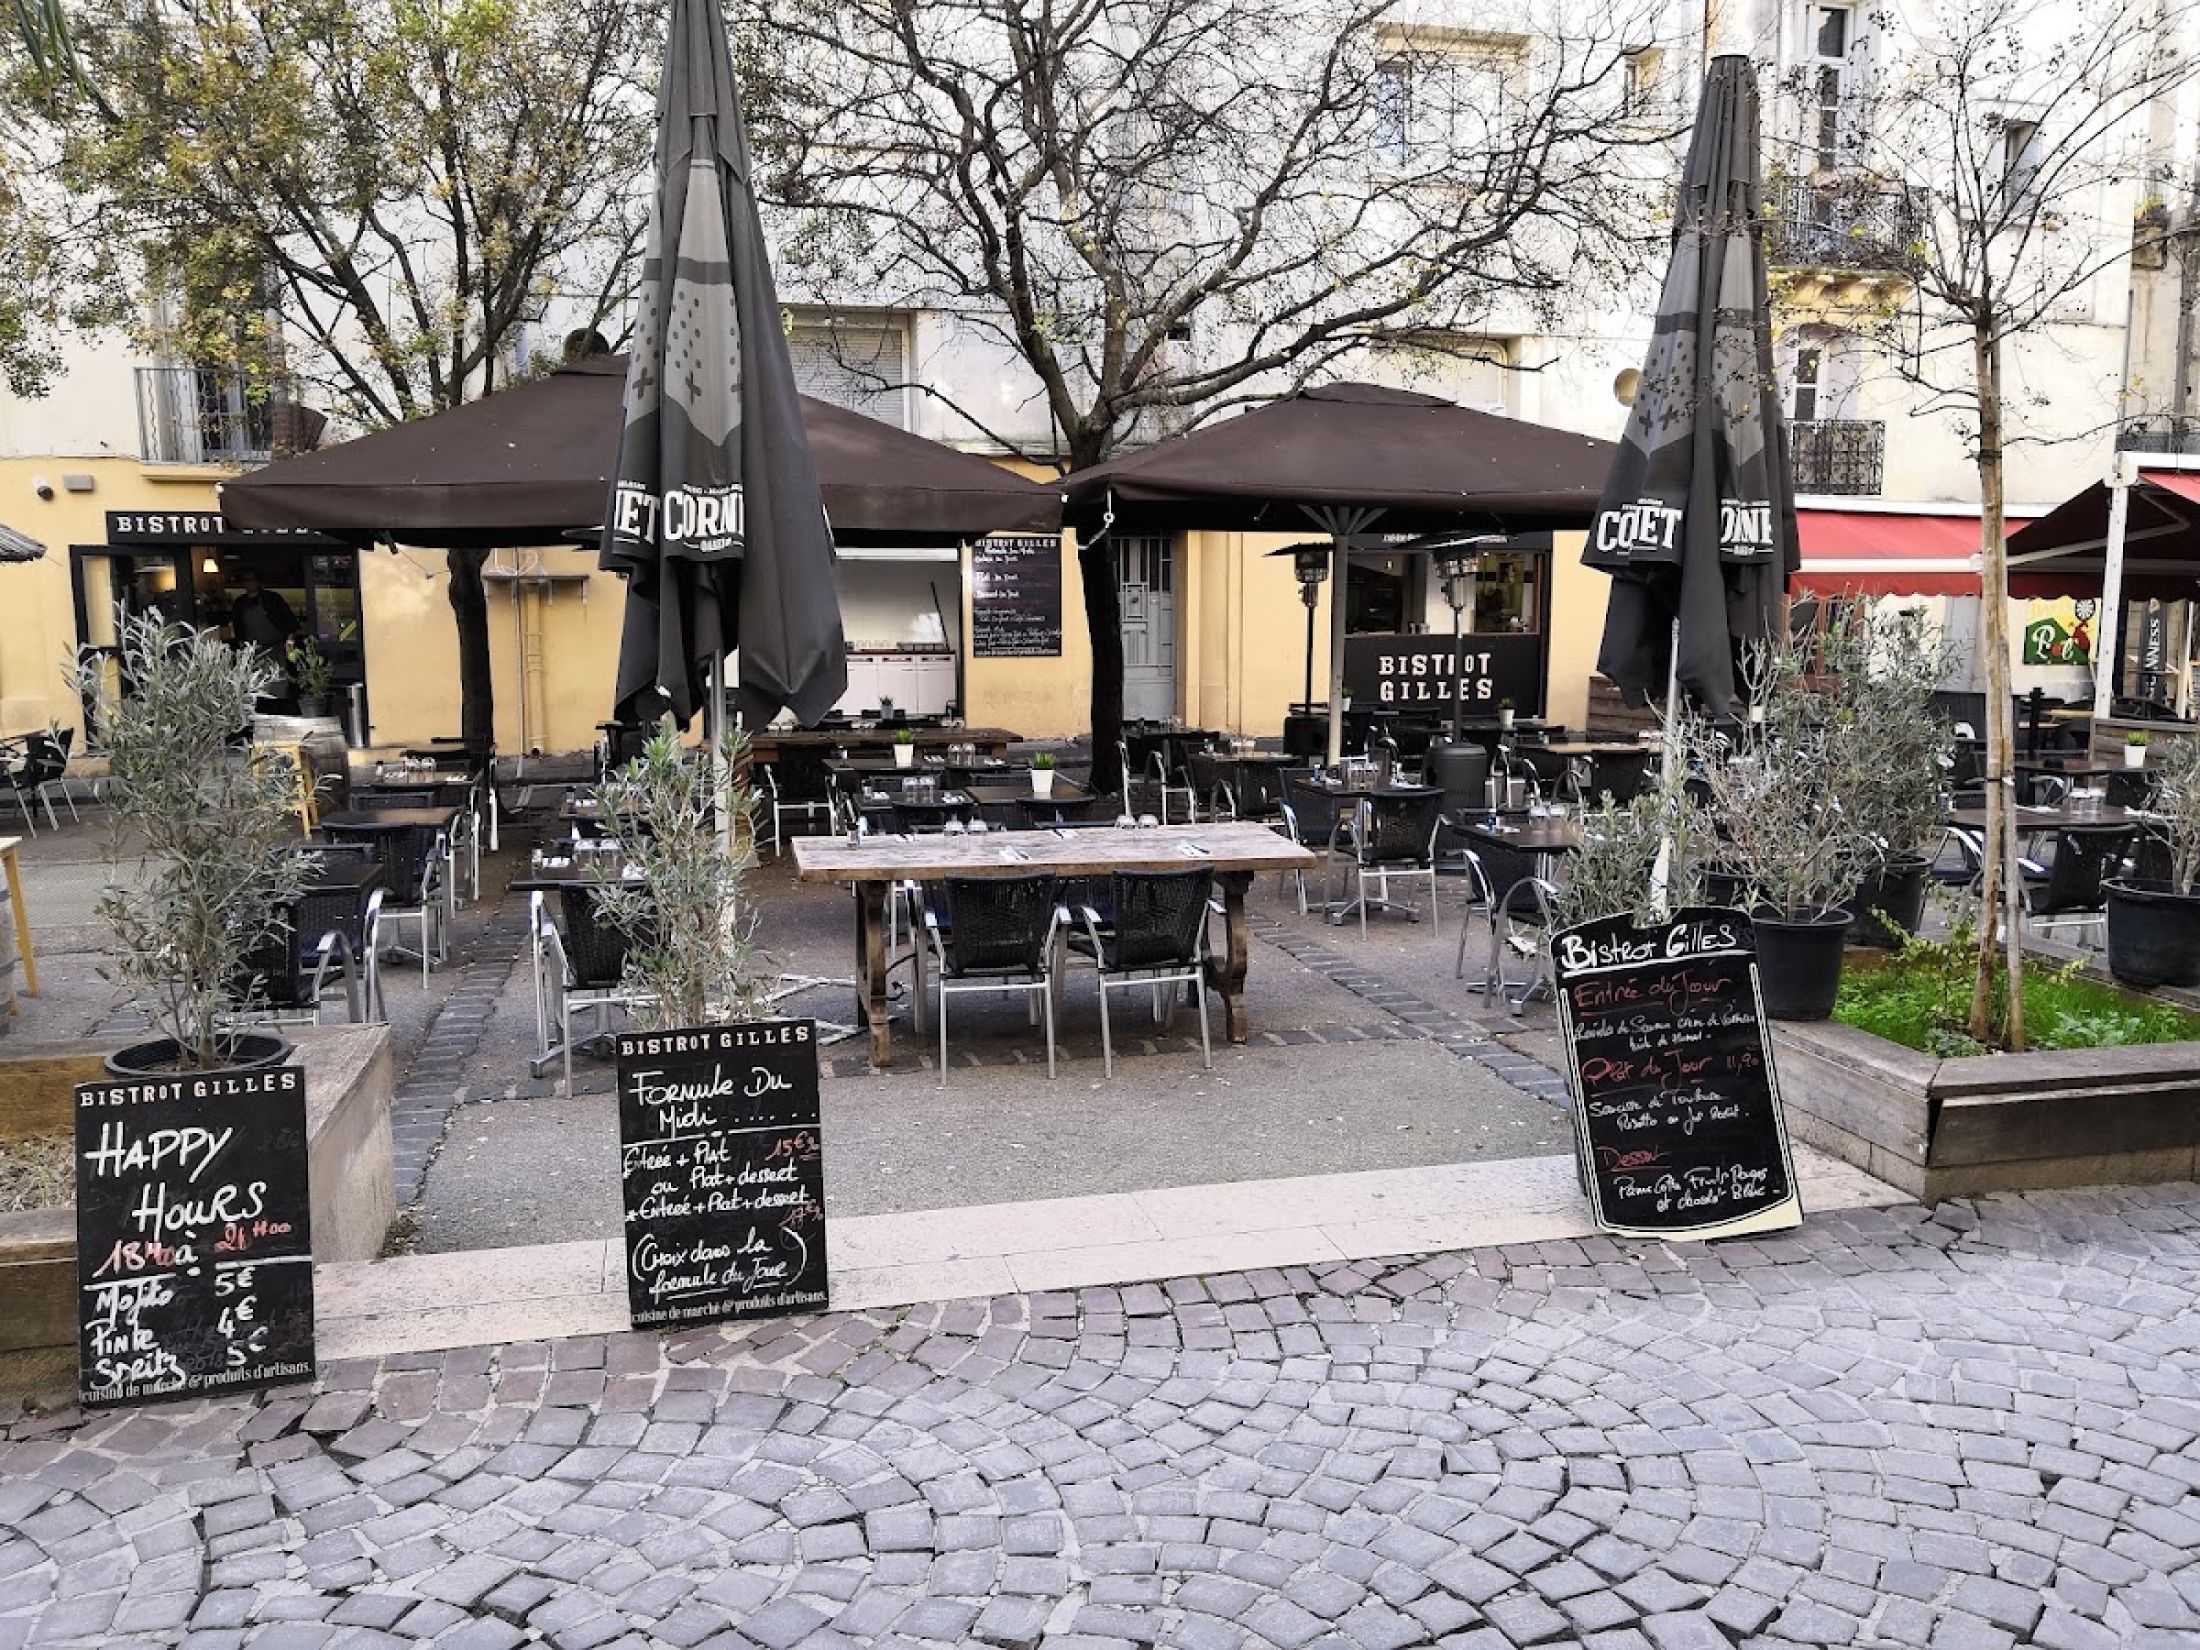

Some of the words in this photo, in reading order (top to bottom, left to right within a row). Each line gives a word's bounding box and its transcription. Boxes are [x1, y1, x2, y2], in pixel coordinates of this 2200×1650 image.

[116, 515, 224, 534] BISTROT
[1380, 677, 1493, 702] GILLES
[621, 1033, 711, 1055] BISTROT
[719, 1026, 809, 1048] GILLES
[80, 1083, 183, 1107] BISTROT
[193, 1073, 297, 1098] GILLES
[659, 1102, 718, 1140] Midi
[631, 1309, 668, 1323] cuisine
[668, 1305, 681, 1319] de
[683, 1302, 721, 1319] marché
[126, 1384, 141, 1398] de
[203, 1367, 252, 1390] produits
